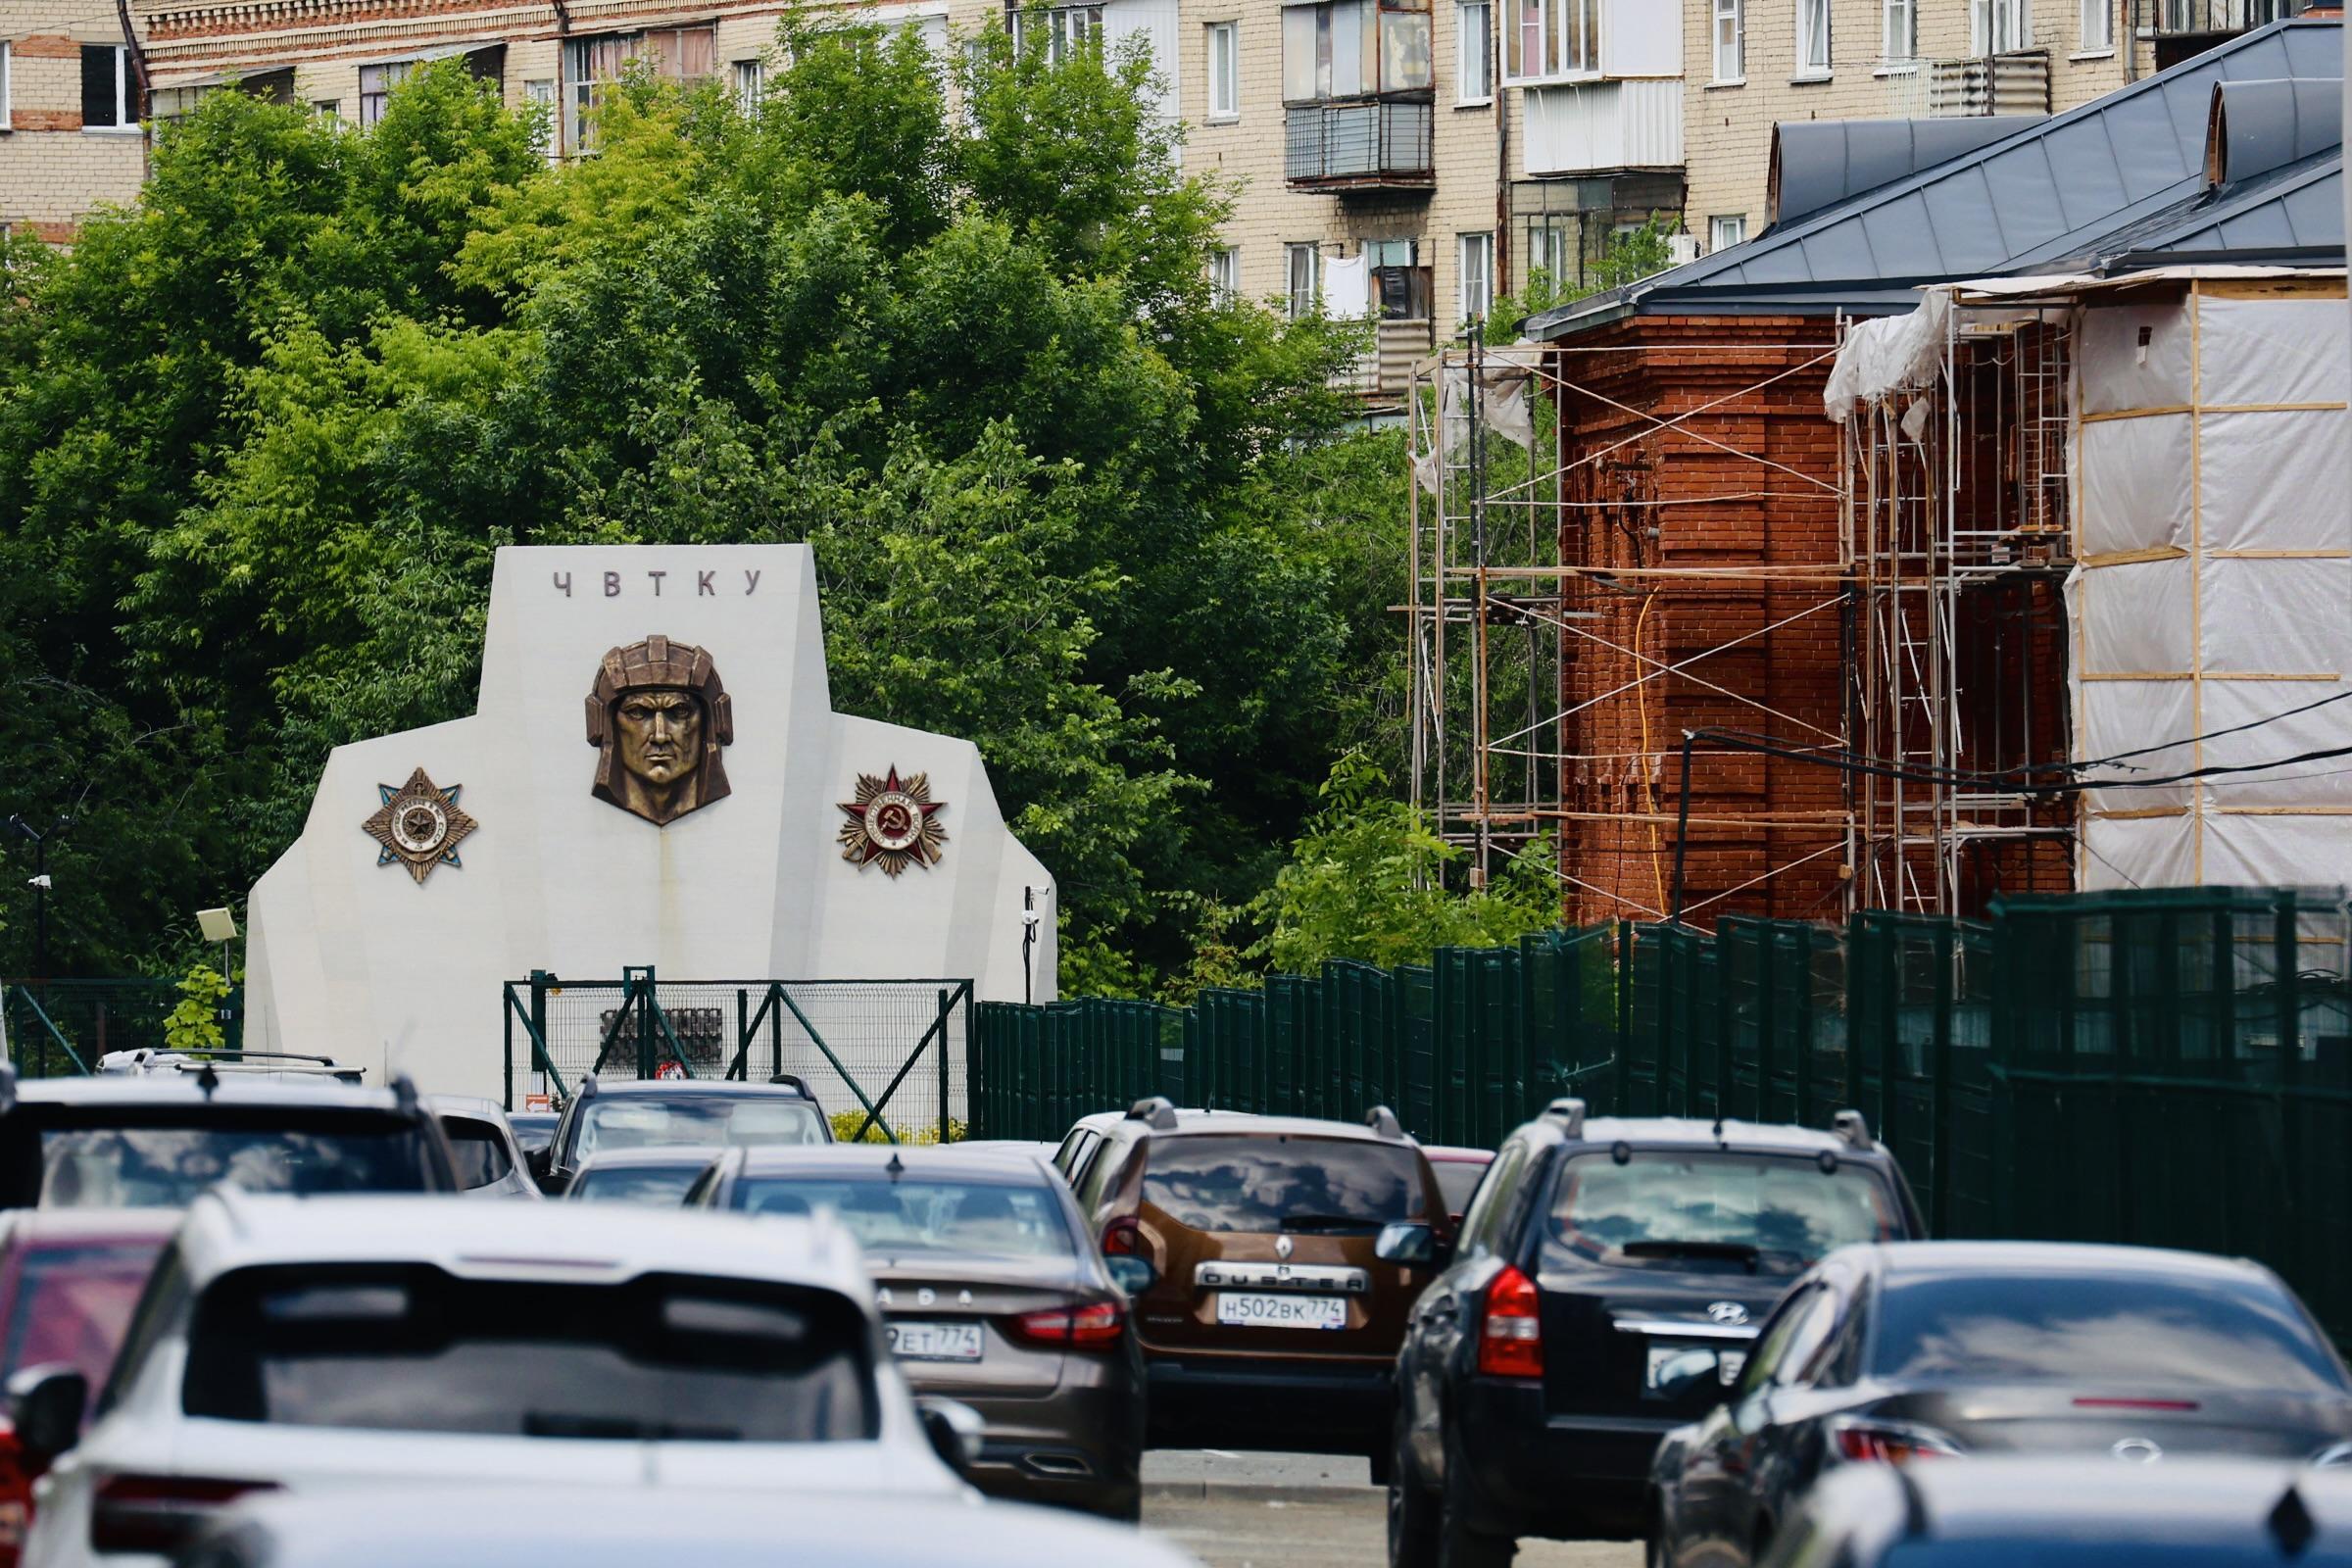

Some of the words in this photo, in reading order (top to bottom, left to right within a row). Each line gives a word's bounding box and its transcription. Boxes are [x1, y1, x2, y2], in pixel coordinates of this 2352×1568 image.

[553, 569, 761, 598] ЧВТКУ
[1204, 1274, 1362, 1290] DUSTER
[877, 1287, 973, 1306] ADA
[1307, 1299, 1341, 1317] 774
